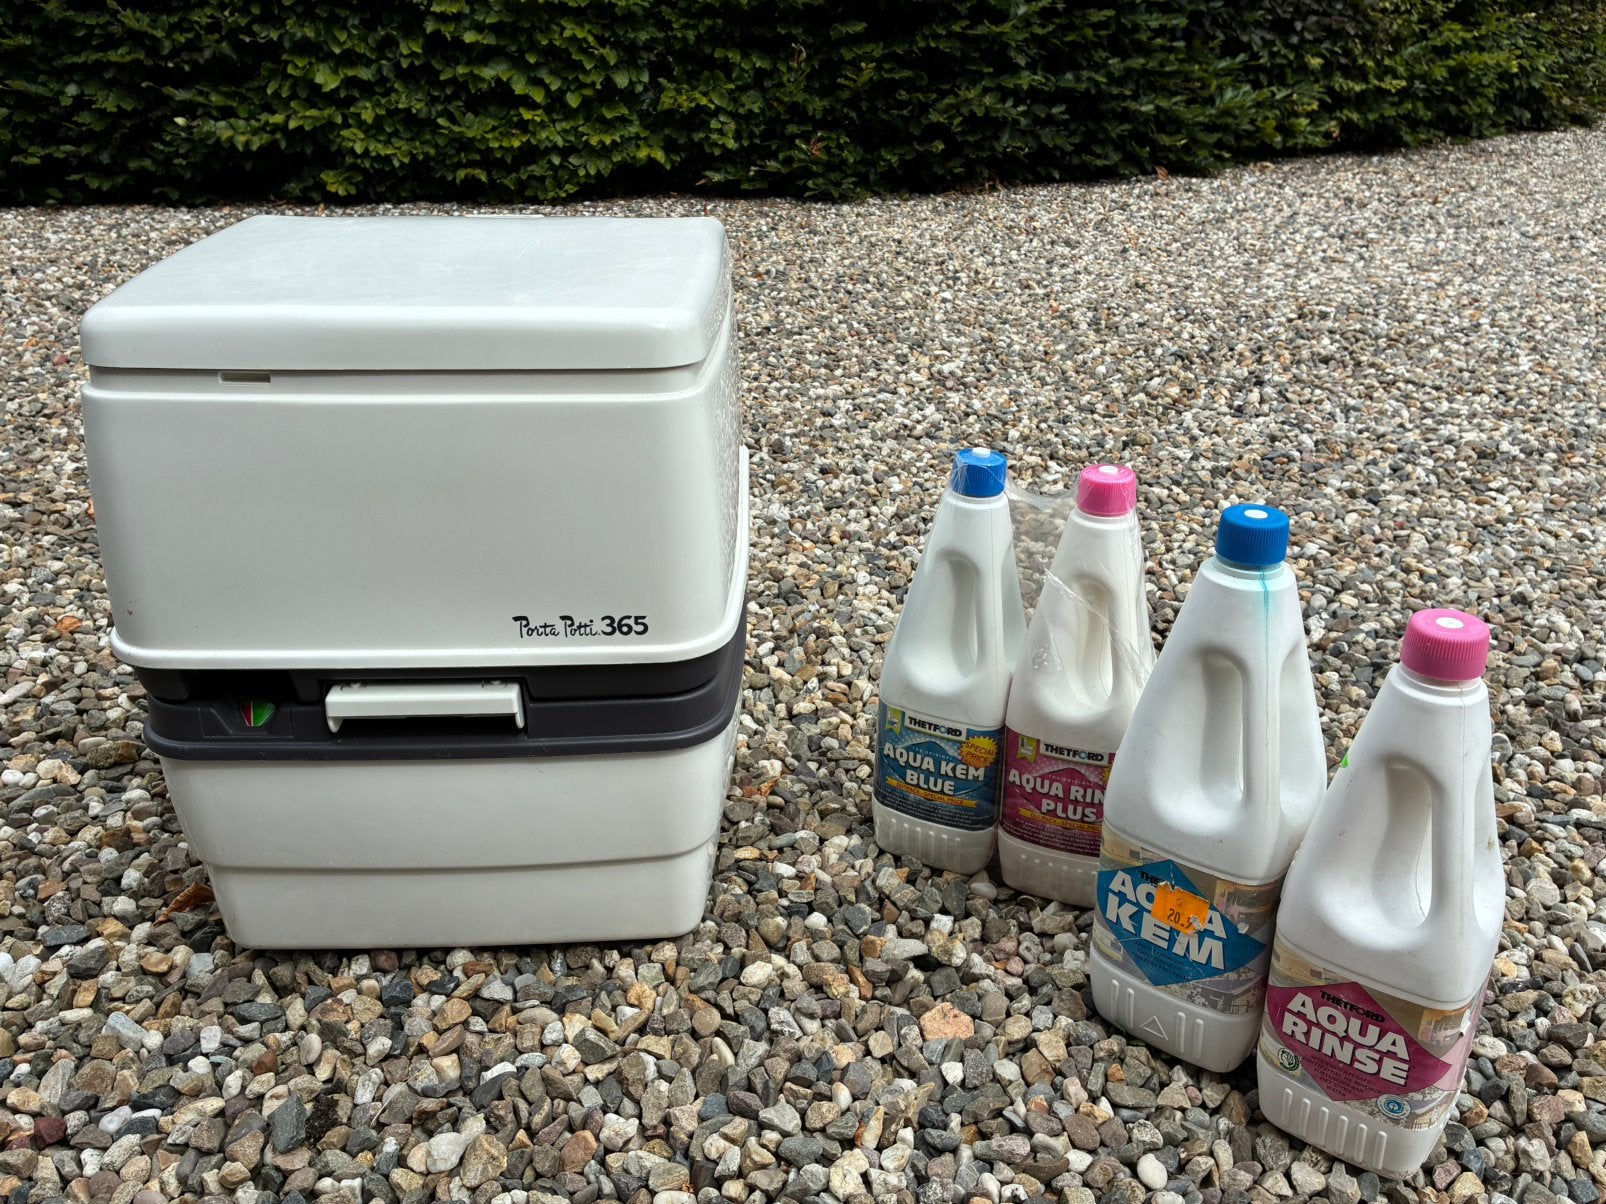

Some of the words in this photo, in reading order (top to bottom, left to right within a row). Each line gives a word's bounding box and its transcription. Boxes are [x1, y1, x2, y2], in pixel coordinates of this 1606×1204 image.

[512, 615, 560, 638] Porta
[559, 615, 598, 638] Potti
[601, 615, 649, 636] 365
[907, 715, 963, 738] THETFORD
[883, 742, 935, 773] AQUA
[940, 760, 986, 782] KEM
[964, 741, 995, 756] SPECIAL
[965, 751, 989, 764] PRICE
[1043, 743, 1105, 763] THETFORD
[905, 769, 955, 796] BLUE
[1008, 768, 1064, 798] AQUA
[1069, 784, 1105, 805] RIN
[1040, 798, 1097, 823] PLUS
[1105, 892, 1225, 971] KEM
[1319, 990, 1386, 1023] THETFORD
[1286, 992, 1411, 1061] AQUA
[1281, 1011, 1411, 1086] RINSE
